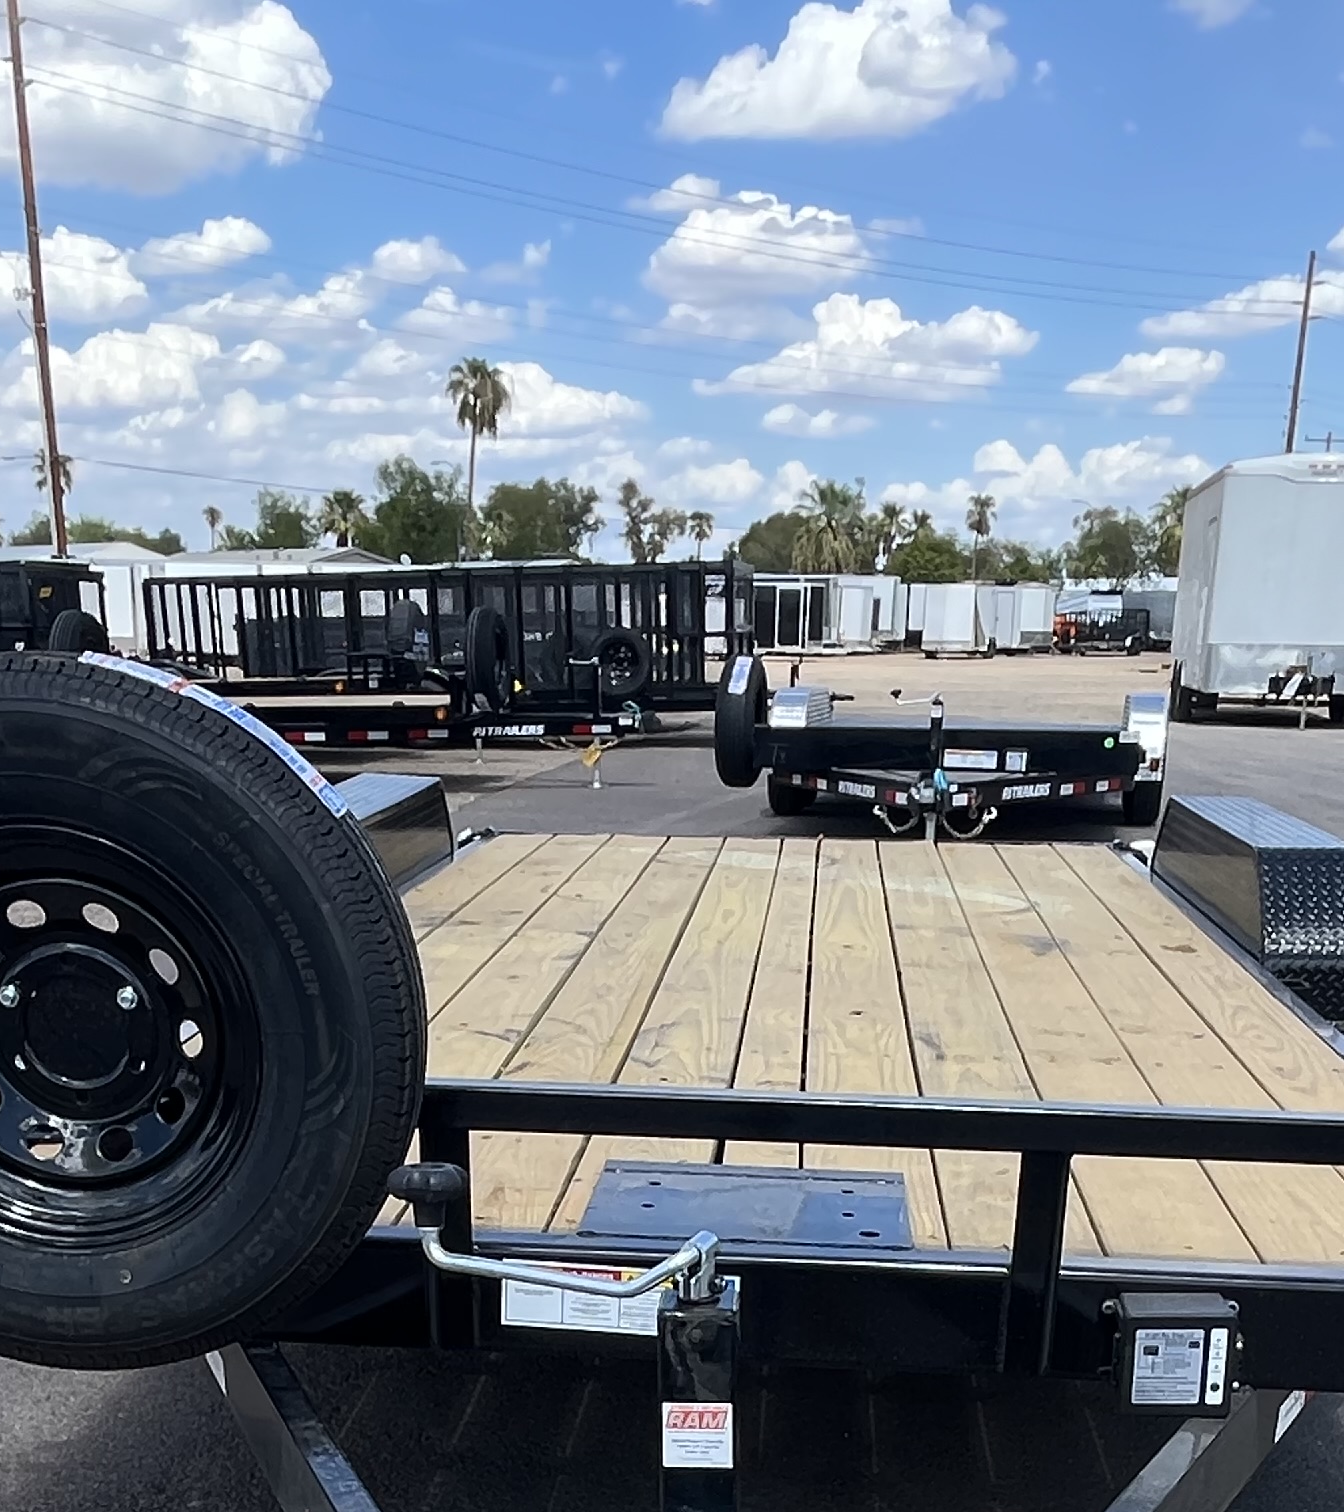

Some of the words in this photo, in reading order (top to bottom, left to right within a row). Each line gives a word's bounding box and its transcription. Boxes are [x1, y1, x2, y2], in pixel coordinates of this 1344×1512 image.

[212, 831, 284, 913] SPECIAL
[274, 910, 320, 996] TRAILER
[666, 1411, 726, 1429] RAM
